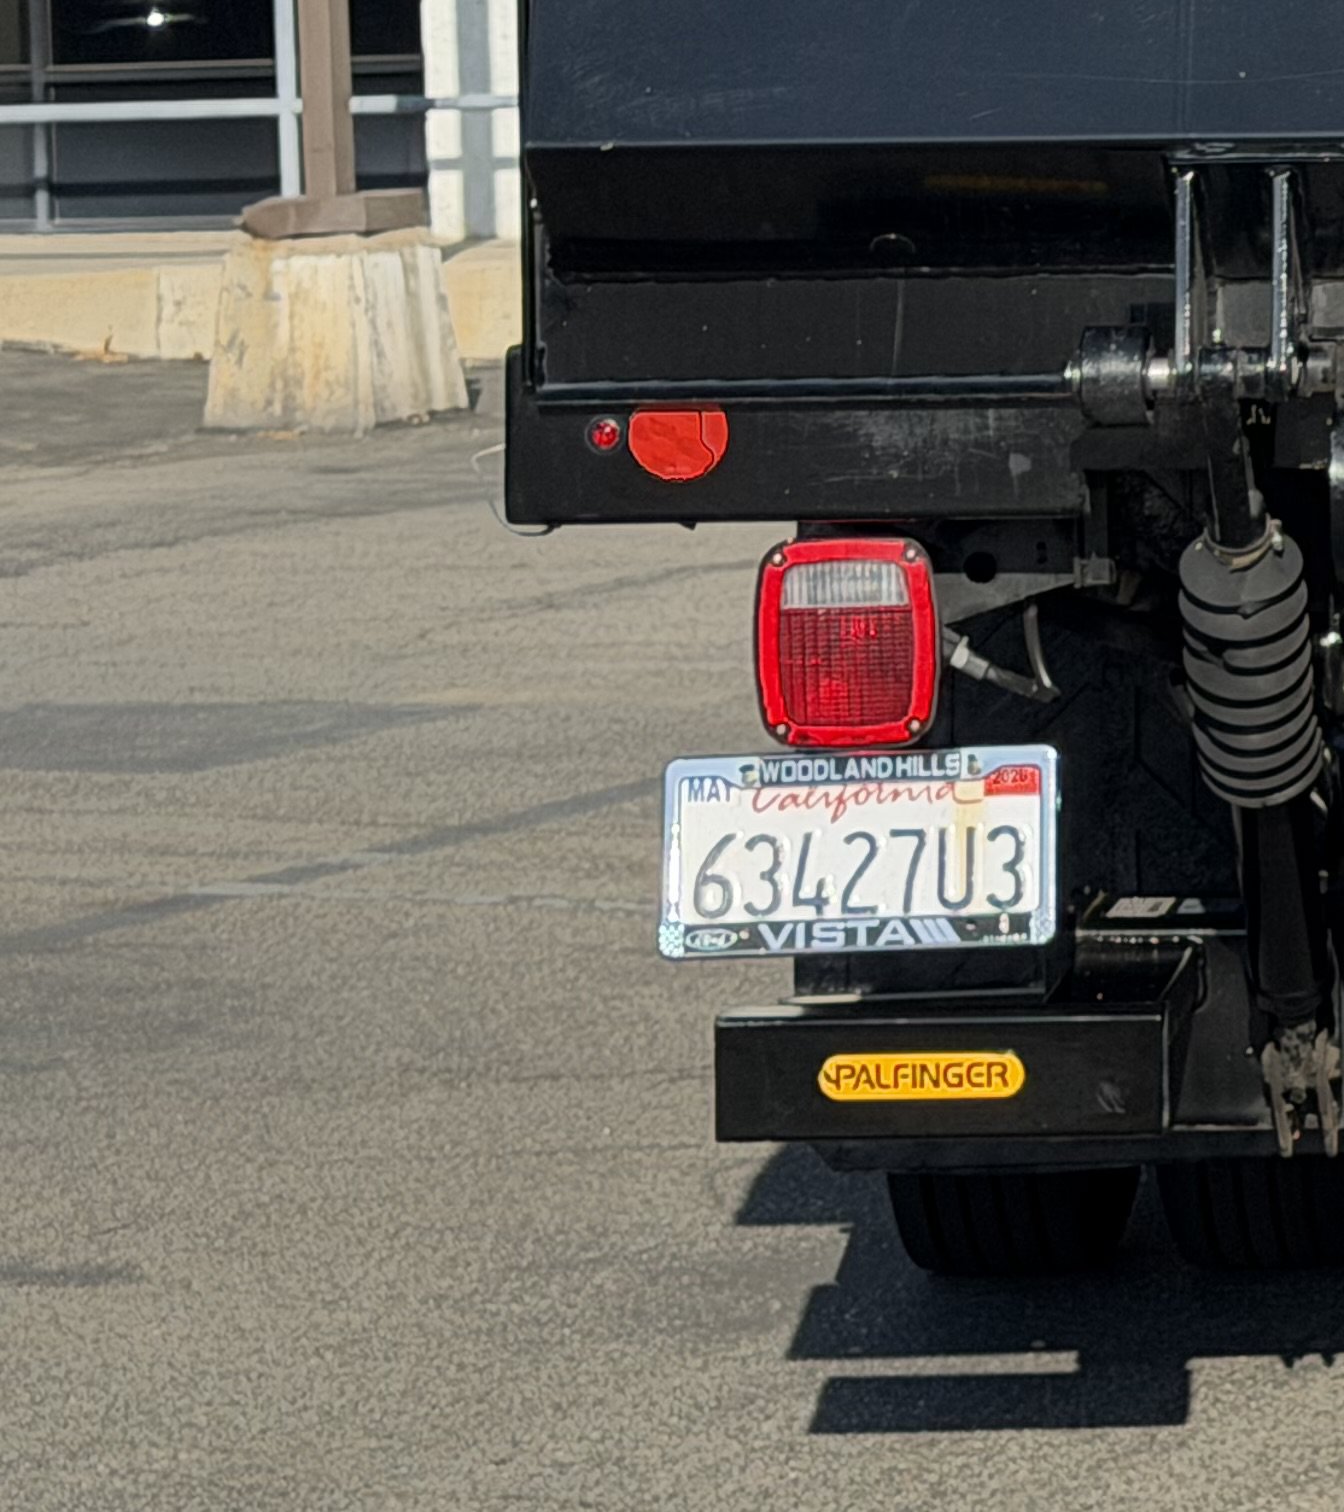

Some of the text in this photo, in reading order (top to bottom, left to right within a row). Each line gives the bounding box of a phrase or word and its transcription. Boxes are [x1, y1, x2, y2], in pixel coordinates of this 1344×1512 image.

[761, 753, 961, 783] WOODLAND HILLS
[693, 825, 1025, 918] 63427U3
[757, 919, 915, 952] VISTA
[833, 1061, 1009, 1090] PALFINGER
